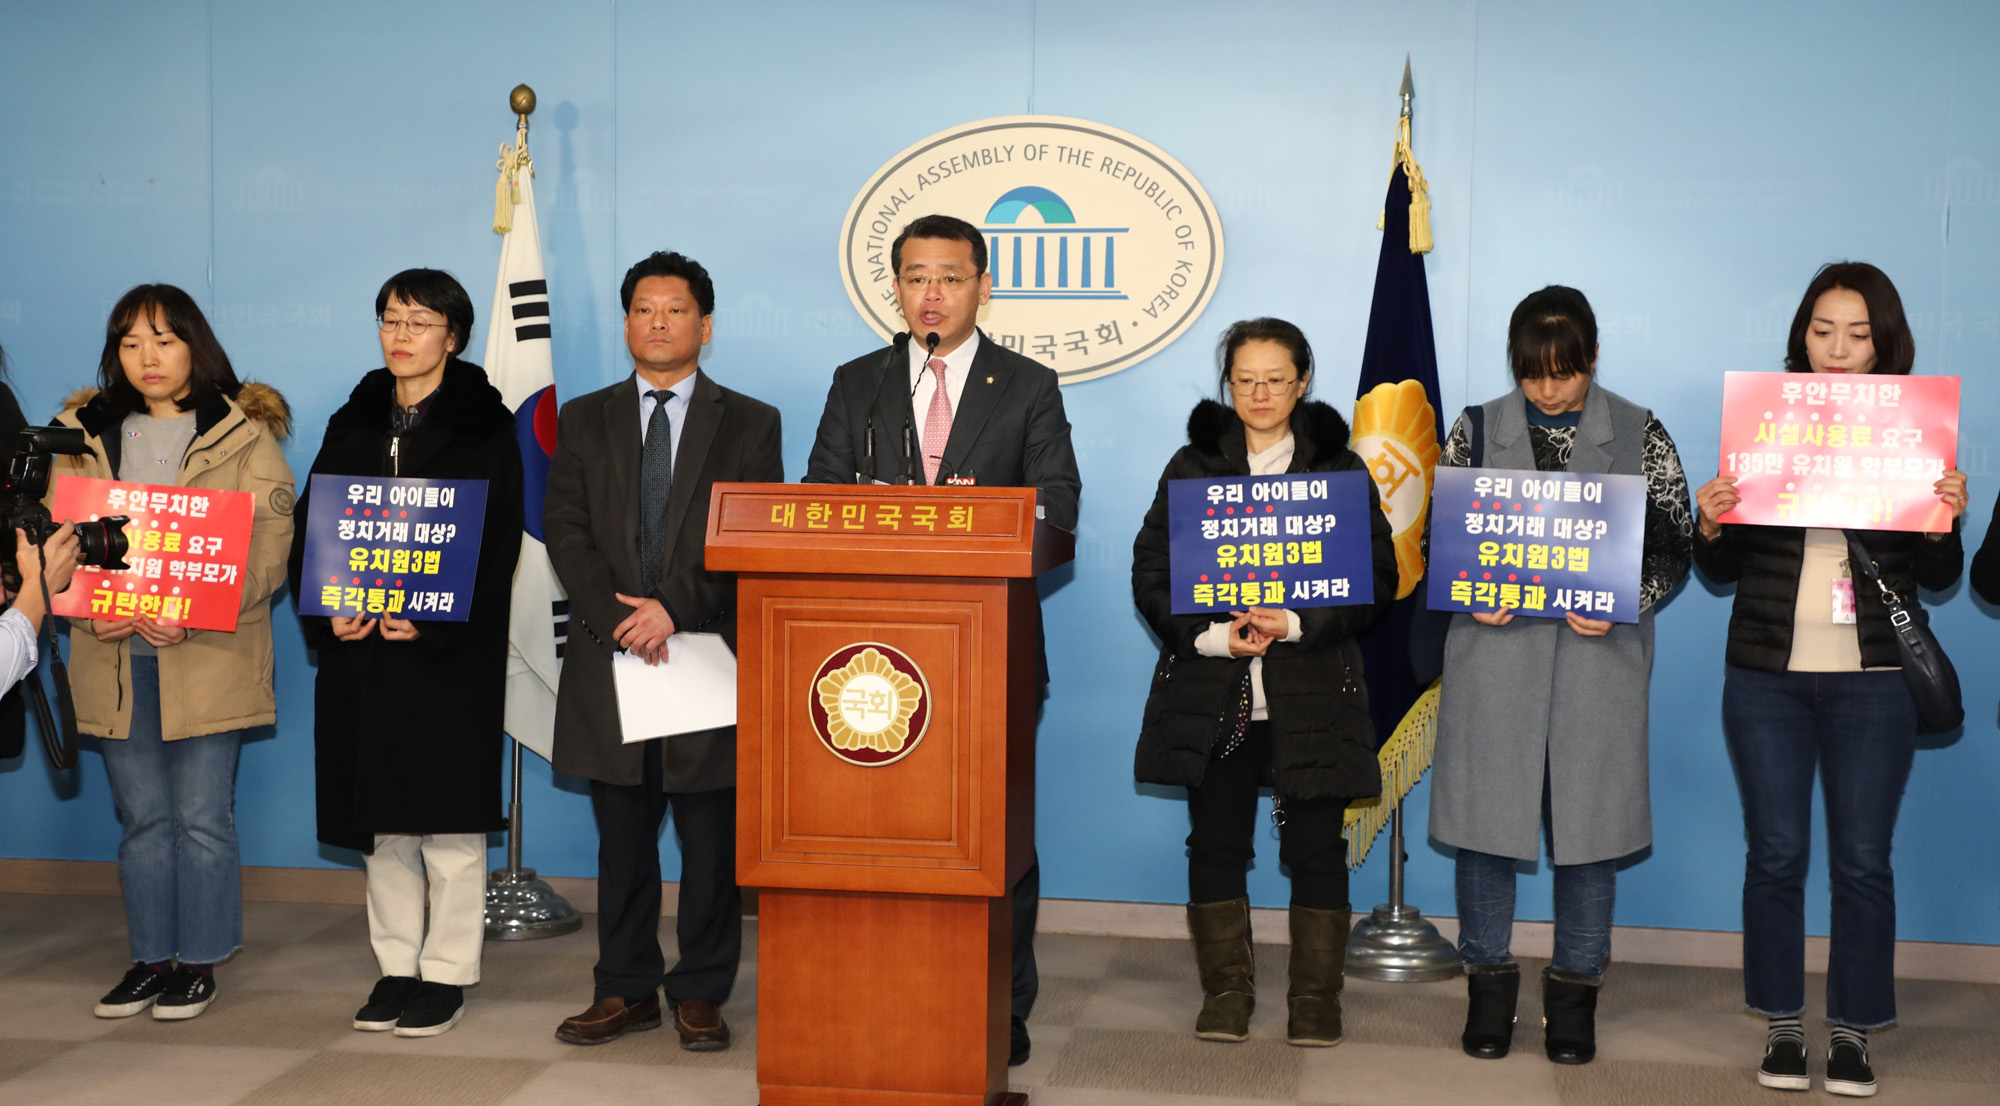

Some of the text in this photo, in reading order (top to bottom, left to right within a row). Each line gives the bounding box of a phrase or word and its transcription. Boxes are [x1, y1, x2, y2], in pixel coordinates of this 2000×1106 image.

[1024, 144, 1049, 161] OF
[1057, 145, 1094, 168] THE
[917, 145, 1015, 191] ASSEMBLY
[1099, 156, 1183, 220] REPUBLIC
[867, 187, 915, 282] NATIONAL
[1174, 225, 1195, 251] OF
[1142, 259, 1193, 319] KOREA
[1781, 381, 1902, 407] 후안무치한
[1754, 422, 1923, 450] 시설사용료 요구
[1727, 452, 1784, 475] 135만
[1792, 454, 1852, 477] 유치원
[107, 488, 210, 518] 후안무치한
[347, 484, 455, 508] 우리 아이들이
[1207, 480, 1328, 505] 우리 아이들이
[1474, 476, 1602, 503] 우리 아이들이
[770, 502, 974, 532] 대한민국국회
[1201, 514, 1336, 540] 정치거래 대상?
[1464, 513, 1608, 540] 정치거래 대상?
[338, 519, 456, 544] 정치거래 대상?
[187, 535, 223, 556] 요구
[1216, 540, 1322, 568] 유치원3법
[1478, 541, 1590, 572] 유치원3법
[169, 560, 238, 585] 학부모가
[349, 547, 441, 574] 유치원3법
[91, 589, 192, 620] 규탄한다!
[321, 585, 454, 613] 즉각통과 시켜라
[1193, 578, 1350, 607] 즉각통과 시켜라
[1451, 580, 1615, 613] 즉각통과 시켜라
[842, 689, 893, 721] 국회
